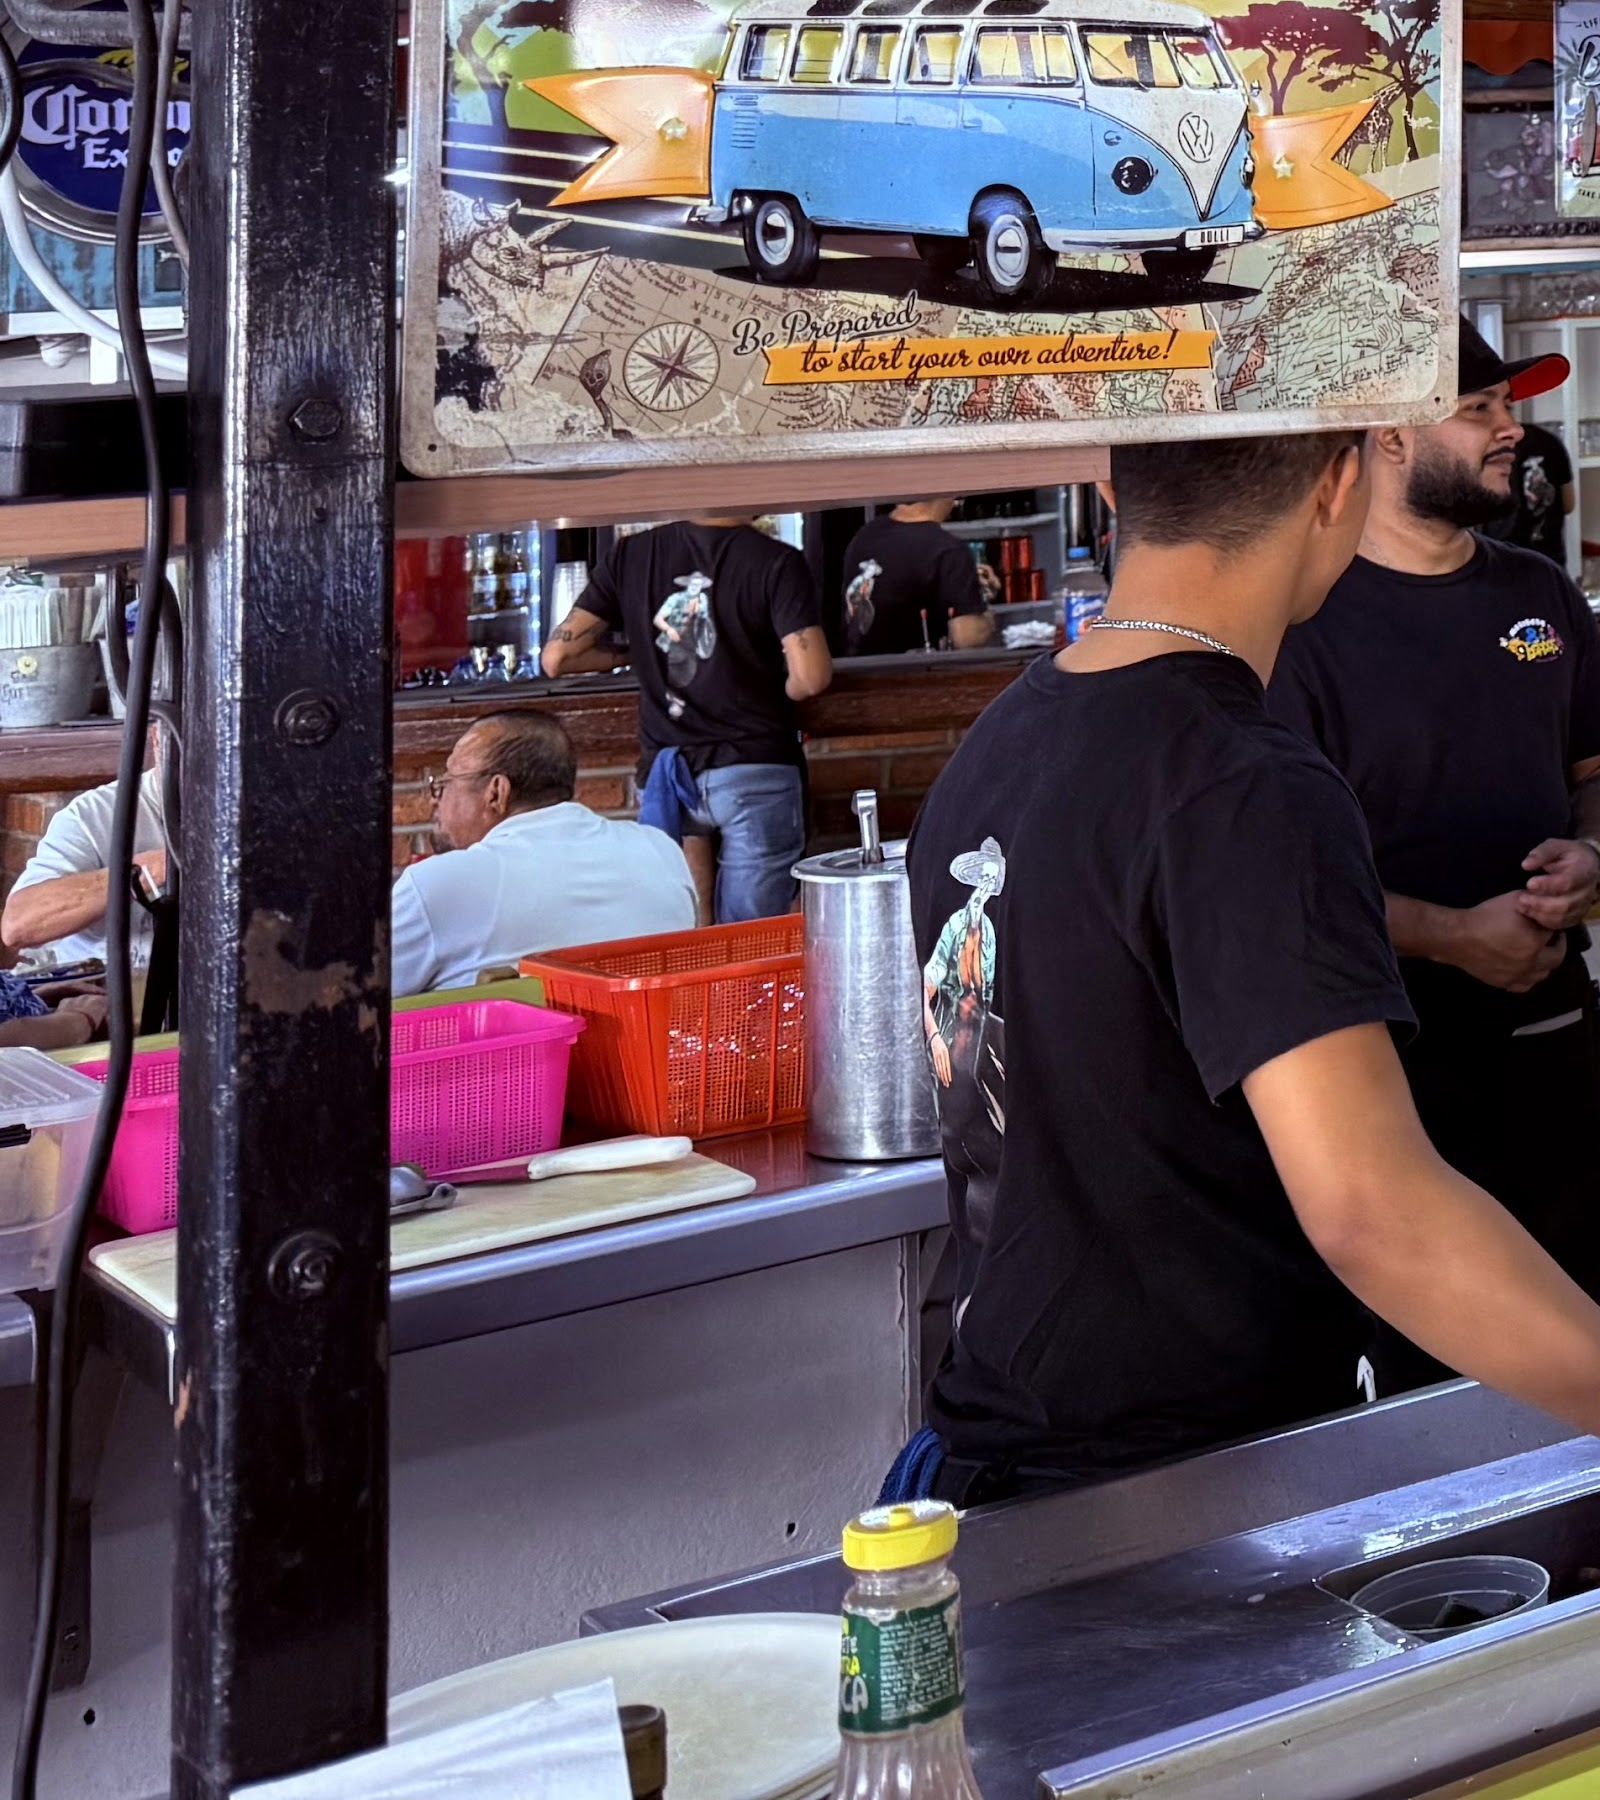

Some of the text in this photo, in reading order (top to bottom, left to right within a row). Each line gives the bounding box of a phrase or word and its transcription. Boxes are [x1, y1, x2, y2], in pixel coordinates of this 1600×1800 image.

[733, 290, 922, 356] Be Prepared
[800, 328, 1178, 387] to start your own adventure!
